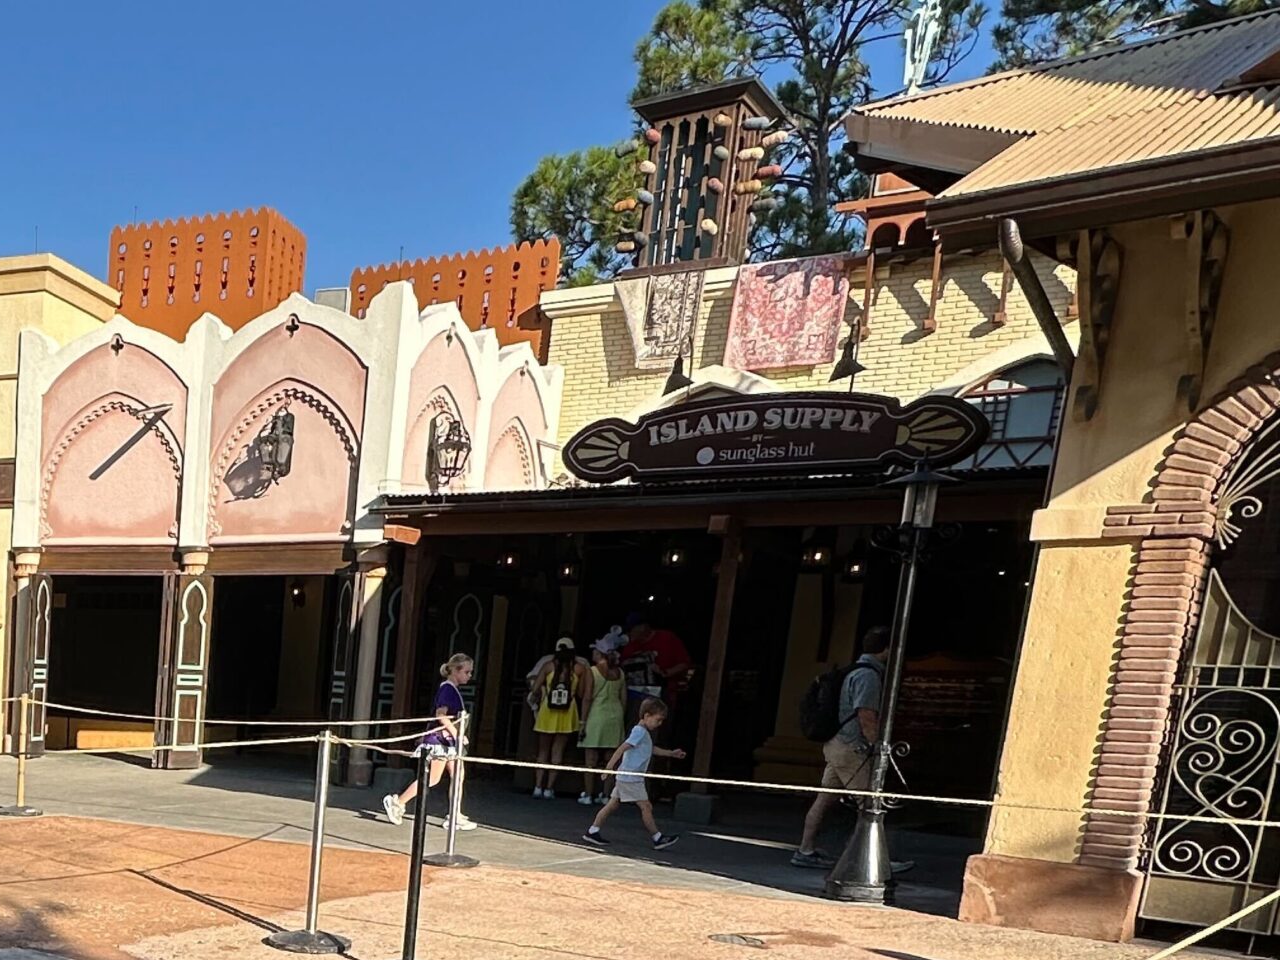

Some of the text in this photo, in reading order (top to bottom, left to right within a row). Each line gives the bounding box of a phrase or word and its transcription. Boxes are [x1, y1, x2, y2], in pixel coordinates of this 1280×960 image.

[648, 408, 880, 446] ISLAND SUPPLY
[719, 441, 815, 463] sunglass hut
